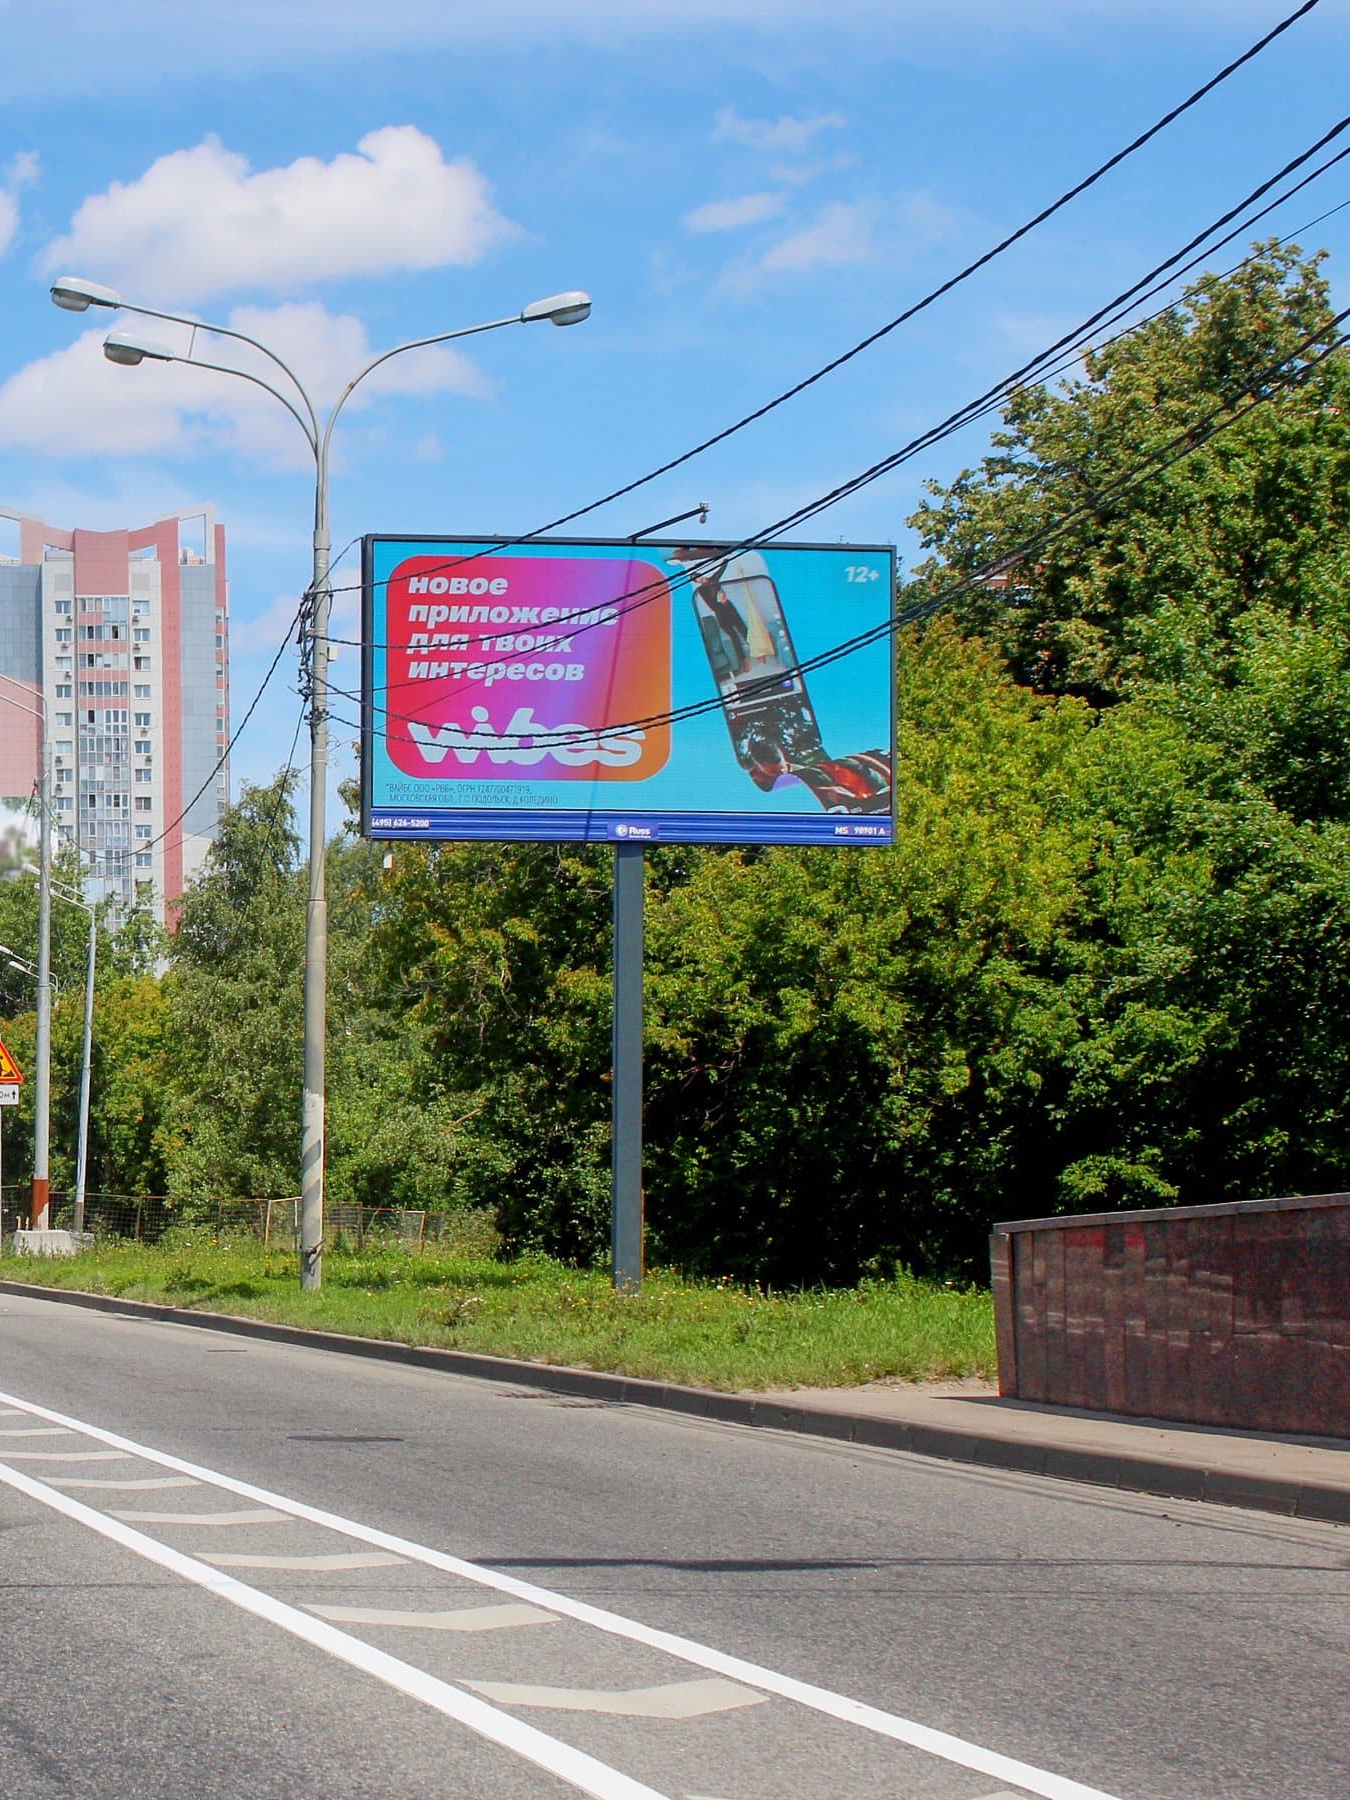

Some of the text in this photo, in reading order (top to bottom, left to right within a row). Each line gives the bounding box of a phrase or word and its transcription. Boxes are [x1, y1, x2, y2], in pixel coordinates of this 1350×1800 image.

[844, 566, 880, 583] 12+
[408, 577, 508, 595] новое
[408, 605, 619, 629] приложение
[406, 633, 575, 655] для твоих
[408, 661, 584, 687] интересов
[408, 705, 646, 767] wibes
[629, 826, 650, 835] Russ
